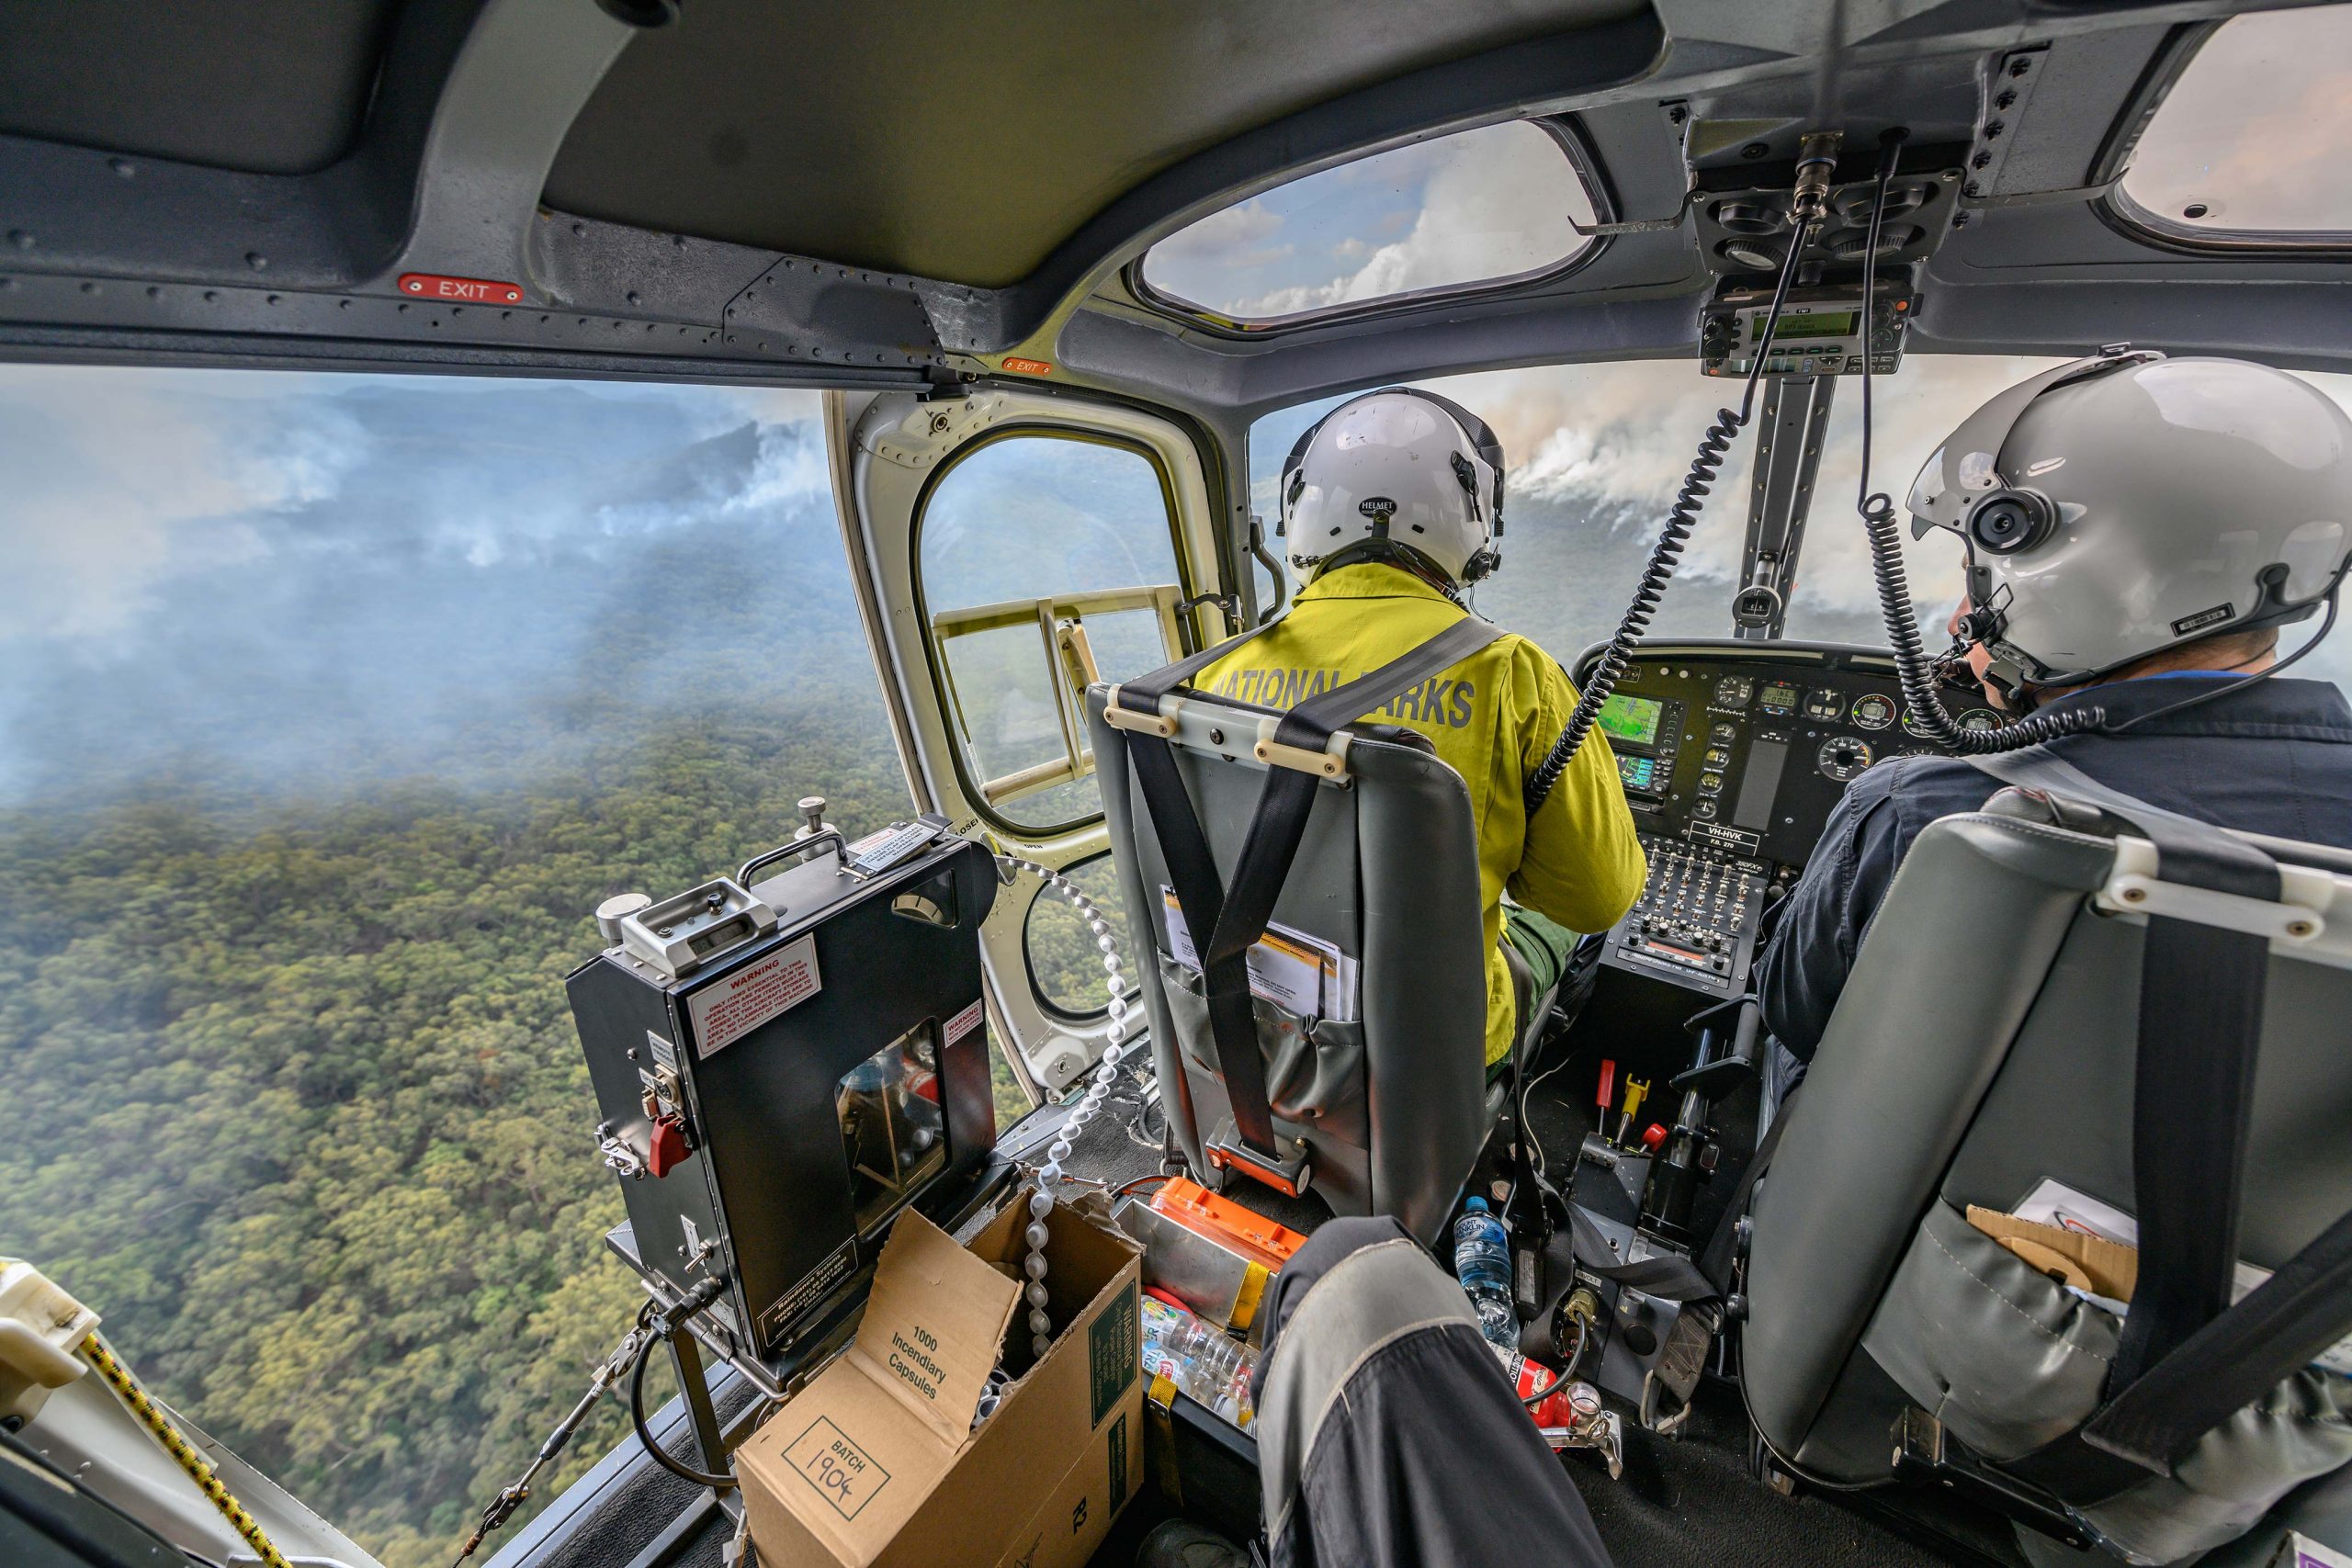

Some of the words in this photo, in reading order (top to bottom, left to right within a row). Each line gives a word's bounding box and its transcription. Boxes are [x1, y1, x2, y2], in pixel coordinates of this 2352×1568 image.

[438, 280, 490, 299] EXIT
[1016, 361, 1039, 373] EXIT
[1362, 502, 1393, 510] HELMET
[1360, 671, 1475, 728] ARKS
[879, 840, 895, 850] LOAD
[956, 818, 978, 837] LOSE
[1709, 827, 1742, 840] VH-HVK
[704, 998, 740, 1021] OPERATION
[741, 991, 753, 1002] ARE
[753, 973, 786, 995] PERMITTED
[795, 962, 807, 972] THIS
[708, 999, 725, 1012] ONLY
[727, 988, 745, 1003] ITEMS
[747, 971, 778, 992] ESSENTIAL
[788, 958, 801, 969] THIS
[729, 958, 779, 990] WARNING
[729, 1005, 740, 1015] ALL
[741, 993, 762, 1008] OTHER
[763, 983, 780, 996] ITEMS
[781, 974, 797, 986] MUST
[707, 1016, 731, 1033] STORED
[741, 1004, 752, 1014] THE
[753, 987, 782, 1007] AIRCRAFT
[707, 1038, 715, 1047] BE
[717, 1033, 723, 1042] IN
[725, 1026, 737, 1037] THE
[738, 1010, 764, 1029] VICINITY
[765, 1005, 773, 1013] OF
[775, 997, 787, 1009] THIS
[788, 983, 813, 1000] MACHINE
[727, 1020, 736, 1029] NO
[737, 999, 772, 1023] FLAMMABLE
[773, 989, 790, 1002] ITEMS
[791, 982, 803, 992] ARE
[803, 977, 810, 986] TO
[948, 1005, 978, 1032] WARNING
[777, 1275, 815, 1311] Raindance
[816, 1252, 841, 1278] Systems
[892, 1332, 946, 1384] Incendiary
[913, 1325, 938, 1352] 1000
[1123, 1303, 1132, 1371] WARNING
[888, 1353, 937, 1400] Capsules
[807, 1449, 854, 1503] 1904
[831, 1439, 866, 1473] BATCH
